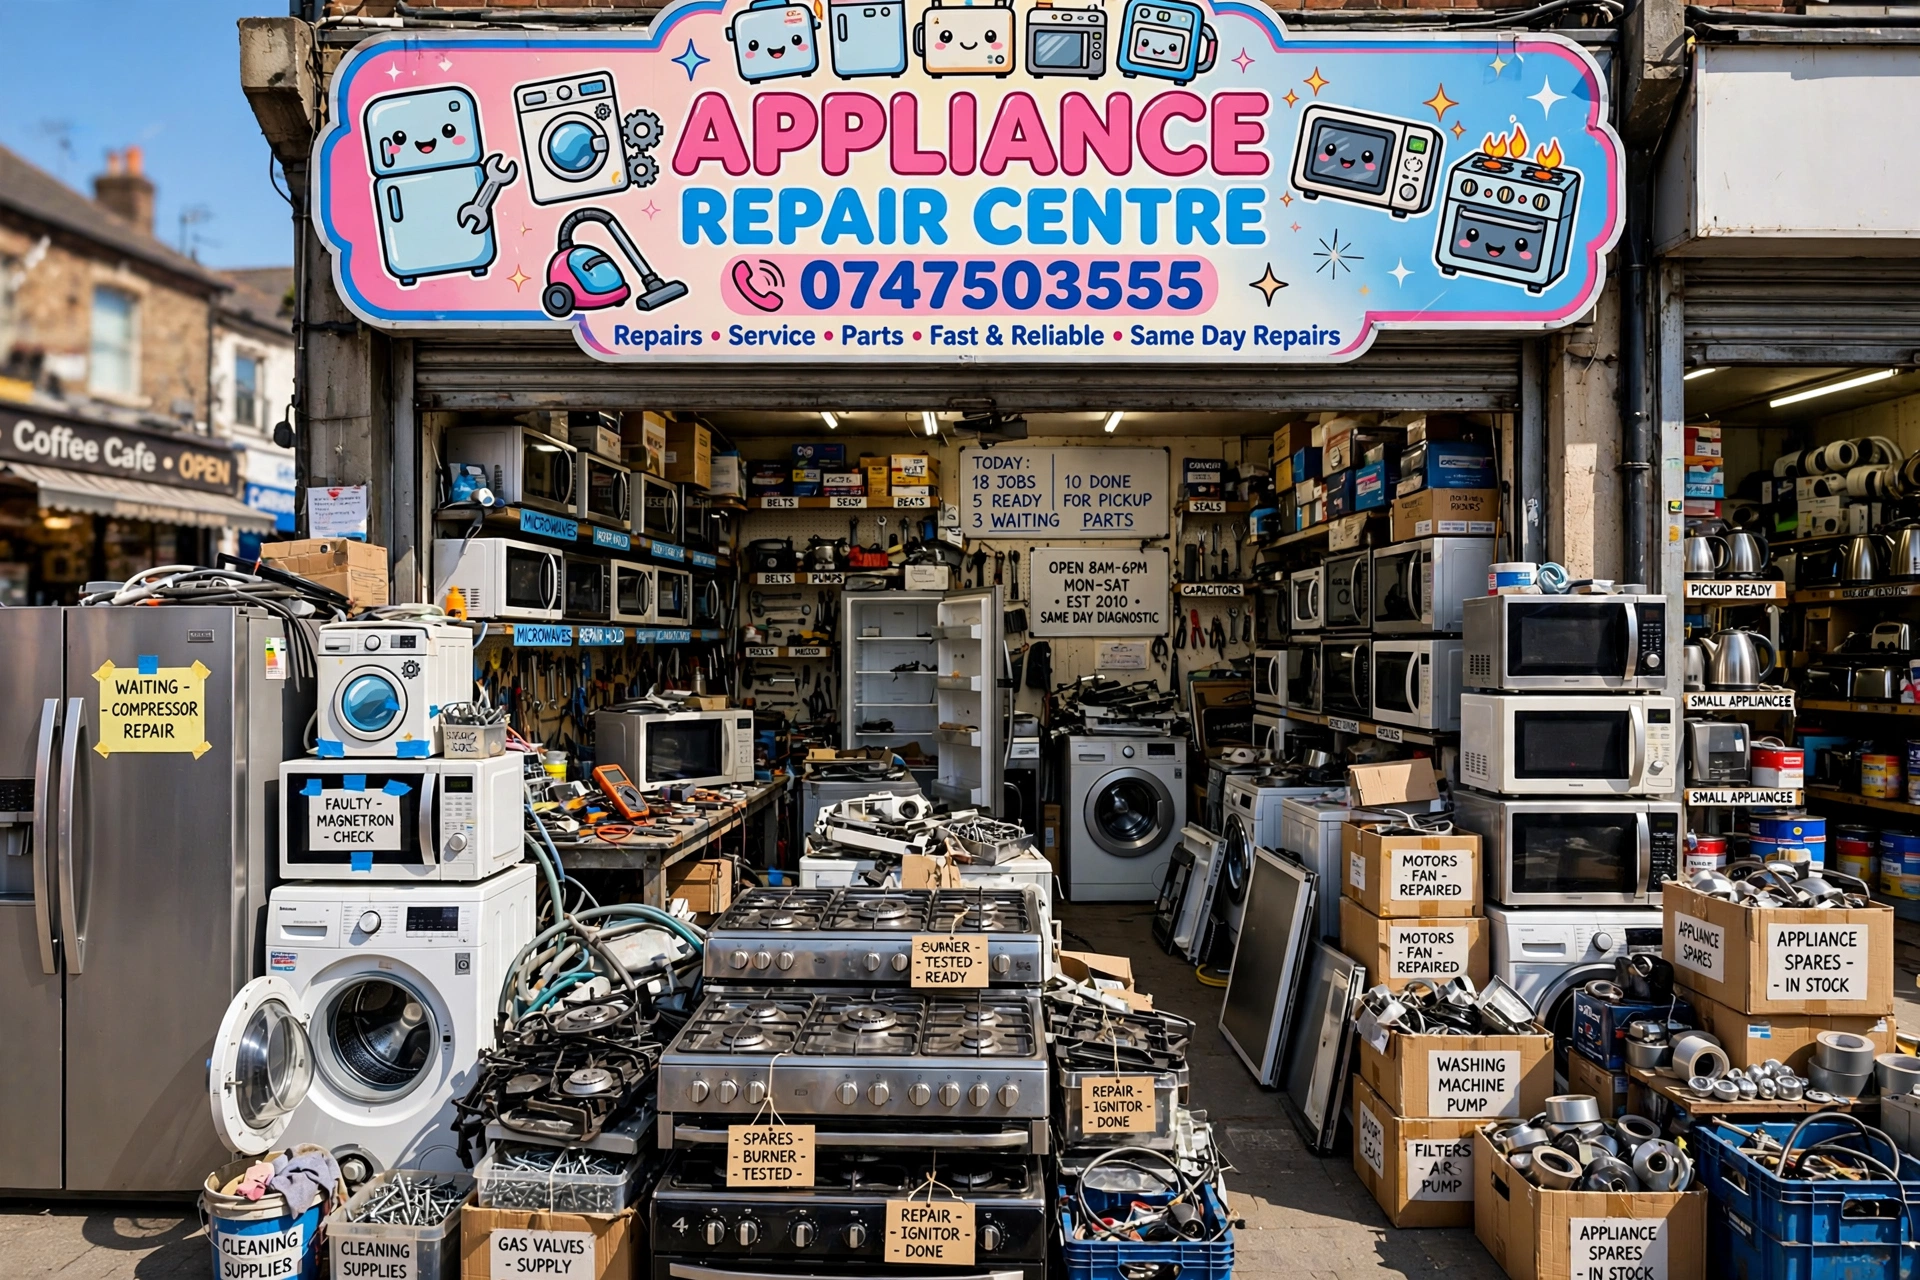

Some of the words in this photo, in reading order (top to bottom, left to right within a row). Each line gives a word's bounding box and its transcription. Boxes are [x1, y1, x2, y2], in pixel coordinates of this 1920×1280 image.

[672, 90, 1270, 177] APPLIANCE
[682, 188, 948, 245] REPAIR
[974, 187, 1266, 245] CENTRE
[801, 260, 1203, 310] 0747503555
[615, 324, 702, 351] Repairs
[729, 324, 815, 346] Service
[842, 325, 903, 345] Parts
[931, 325, 978, 345] Fast
[986, 325, 1003, 345] &
[1012, 324, 1104, 345] Reliable
[1131, 325, 1194, 345] Same
[1202, 325, 1246, 351] Day
[1254, 324, 1340, 351] Repairs
[13, 421, 98, 462] Coffee
[104, 438, 156, 472] Cafe
[179, 452, 230, 484] OPEN
[972, 456, 1029, 469] TODAY:
[973, 475, 989, 489] 18
[997, 475, 1035, 489] JOBS
[1065, 475, 1081, 488] 10
[1090, 475, 1131, 488] DONE
[767, 499, 794, 507] BELTS
[973, 494, 982, 507] 5
[993, 494, 1042, 507] READY
[1064, 494, 1091, 507] FOR
[1099, 493, 1152, 507] PICKUP
[1194, 503, 1222, 511] SEALS
[524, 513, 577, 538] MICROWAVES
[973, 513, 982, 528] 3
[991, 513, 1059, 528] WAITING
[1084, 513, 1133, 527] PARTS
[1049, 562, 1083, 574] OPEN
[1089, 561, 1147, 574] 8AM-6PM
[765, 574, 791, 583] BELTS
[1065, 579, 1130, 591] MON-SAT
[1183, 585, 1241, 596] CAPACITORS
[1692, 585, 1732, 595] PICKUP
[1736, 585, 1771, 596] READY
[1067, 595, 1090, 608] EST
[1096, 595, 1127, 608] 2010
[1041, 612, 1069, 623] SAME
[1073, 612, 1093, 623] DAY
[1098, 611, 1159, 623] DIAGNOSTIC
[518, 628, 570, 642] MICROWAVES
[115, 679, 178, 694] WAITING
[1692, 696, 1725, 706] SMALL
[112, 701, 198, 716] COMPRESSOR
[124, 723, 174, 738] REPAIR
[326, 798, 372, 810] FAULTY
[1693, 792, 1727, 802] SMALL
[317, 814, 393, 827] MAGNETRON
[334, 831, 374, 842] CHECK
[1403, 855, 1457, 867] MOTORS
[1412, 870, 1436, 881] FAN
[1400, 884, 1461, 896] REPAIRED
[1400, 932, 1454, 944] MOTORS
[1679, 921, 1719, 949] APPLIANCE
[1777, 931, 1857, 947] APPLIANCE
[1408, 947, 1432, 958] FAN
[1683, 944, 1712, 968] SPARES
[925, 956, 972, 968] TESTED
[1398, 961, 1459, 973] REPAIRED
[1785, 954, 1841, 970] SPARES
[926, 971, 967, 983] READY
[1786, 977, 1800, 992] IN
[1806, 977, 1849, 992] STOCK
[1437, 1057, 1505, 1072] WASHING
[1093, 1085, 1133, 1097] REPAIR
[1439, 1078, 1505, 1092] MACHINE
[1093, 1101, 1143, 1112] IGNITOR
[1448, 1098, 1487, 1112] PUMP
[1098, 1116, 1129, 1128] DONE
[744, 1132, 793, 1145] SPARES
[744, 1150, 796, 1163] BURNER
[1415, 1144, 1472, 1157] FILTERS
[742, 1167, 792, 1180] TESTED
[1422, 1179, 1462, 1193] PUMP
[902, 1209, 951, 1223] REPAIR
[672, 1217, 688, 1236] 4
[901, 1226, 960, 1241] IGNITOR
[1580, 1226, 1657, 1241] APPLIANCE
[223, 1231, 297, 1255] CLEANING
[341, 1241, 409, 1258] CLEANING
[499, 1237, 527, 1252] GAS
[533, 1238, 584, 1254] VALVES
[906, 1244, 943, 1258] DONE
[1589, 1246, 1642, 1260] SPARES
[344, 1262, 406, 1279] SUPPLIES
[517, 1258, 572, 1274] SUPPLY
[1589, 1267, 1603, 1280] IN
[1609, 1266, 1654, 1280] STOCK
